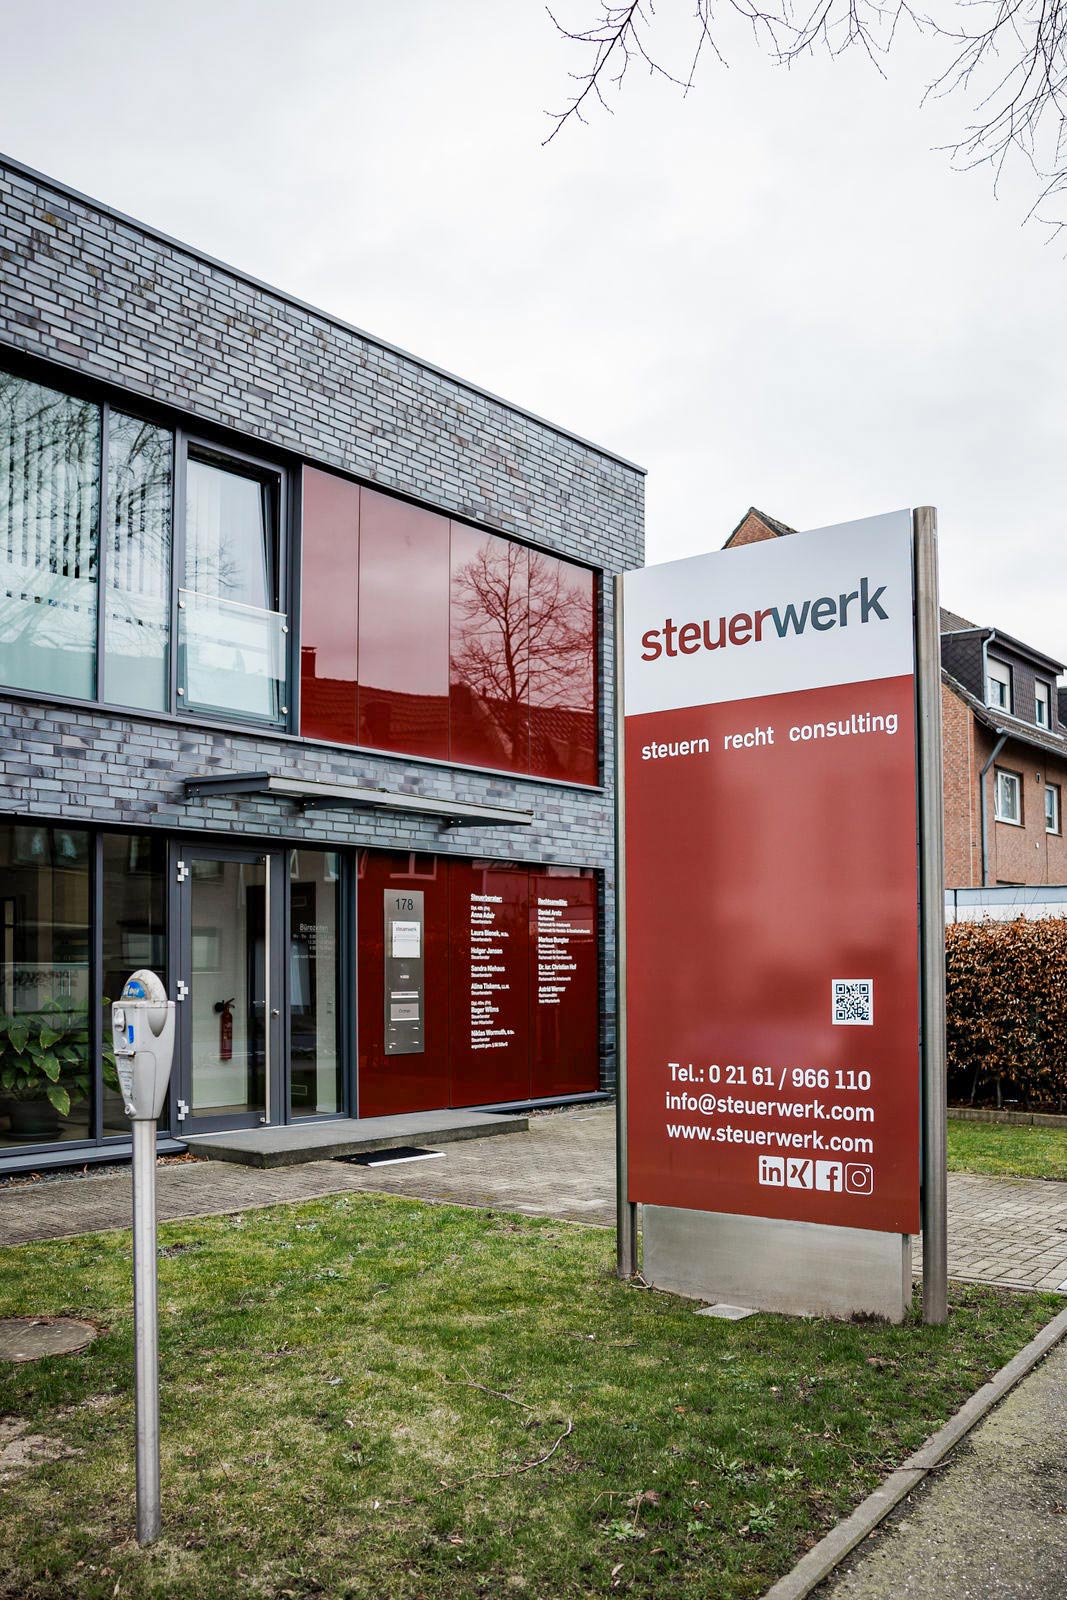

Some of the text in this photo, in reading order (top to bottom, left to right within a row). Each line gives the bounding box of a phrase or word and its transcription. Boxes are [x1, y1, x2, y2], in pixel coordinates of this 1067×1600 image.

[641, 577, 889, 661] steuerwerk
[641, 712, 898, 760] steuern recht consulting
[396, 899, 413, 911] 178
[471, 947, 486, 955] Holger
[667, 1063, 871, 1091] Tel.: 0 21 61 / 966 110
[666, 1092, 874, 1122] info@steuerwerk.com
[666, 1123, 874, 1153] www.steuerwerk.com
